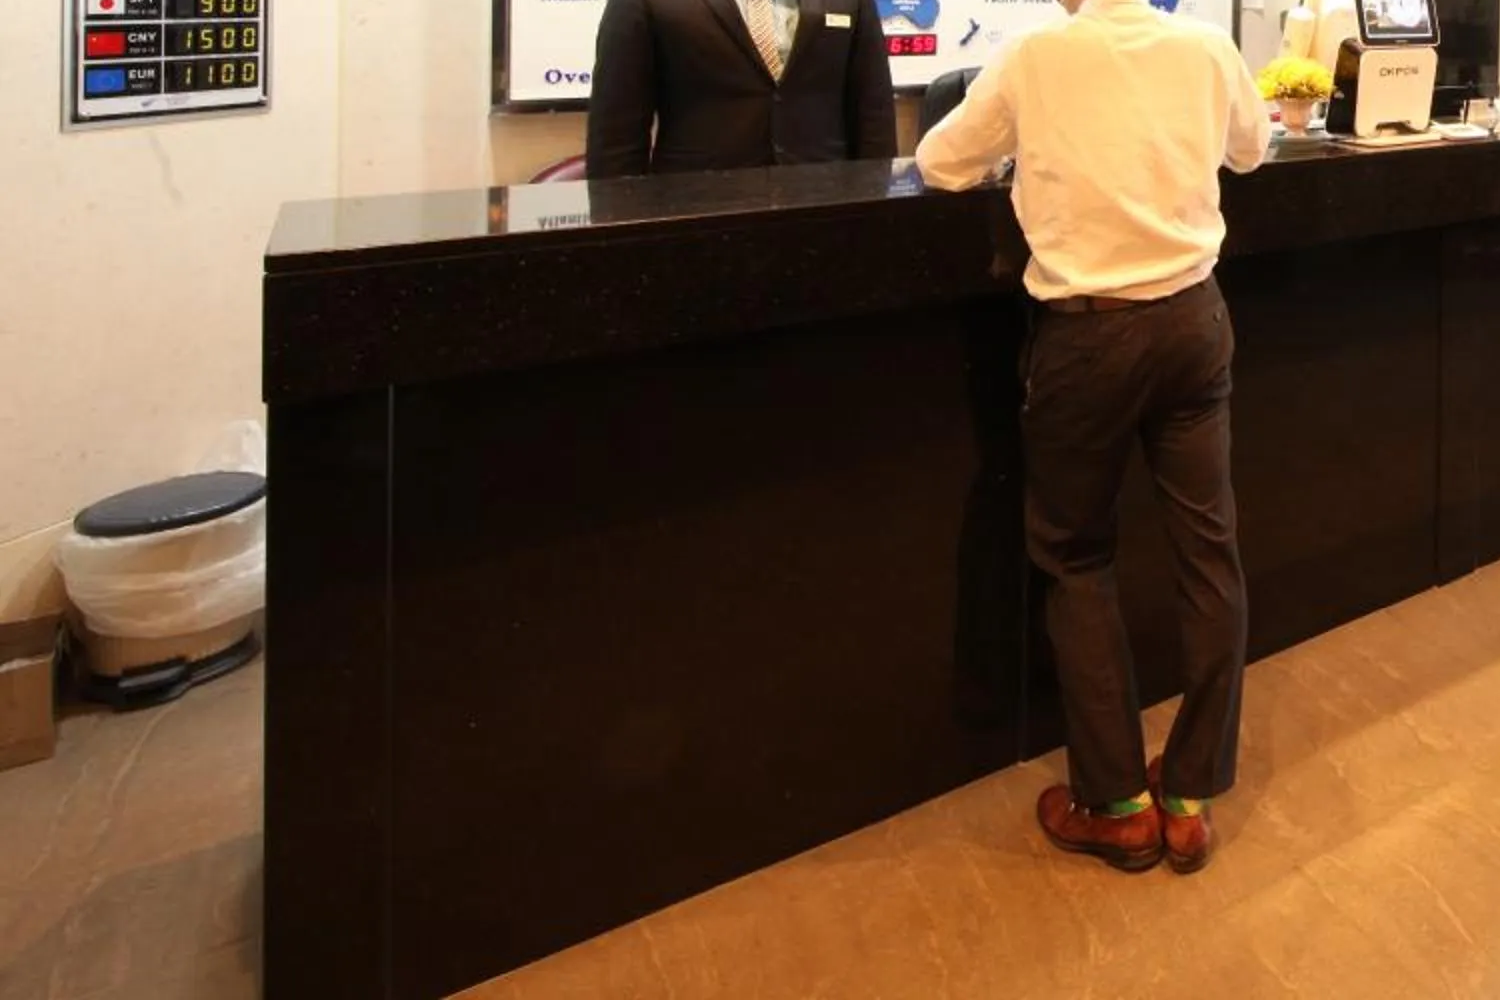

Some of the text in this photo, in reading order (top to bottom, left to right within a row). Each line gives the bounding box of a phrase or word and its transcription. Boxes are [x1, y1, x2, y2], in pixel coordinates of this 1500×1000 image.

[127, 32, 157, 43] CNY
[186, 27, 255, 49] 1500
[127, 69, 156, 79] EUR
[185, 62, 255, 85] 1100
